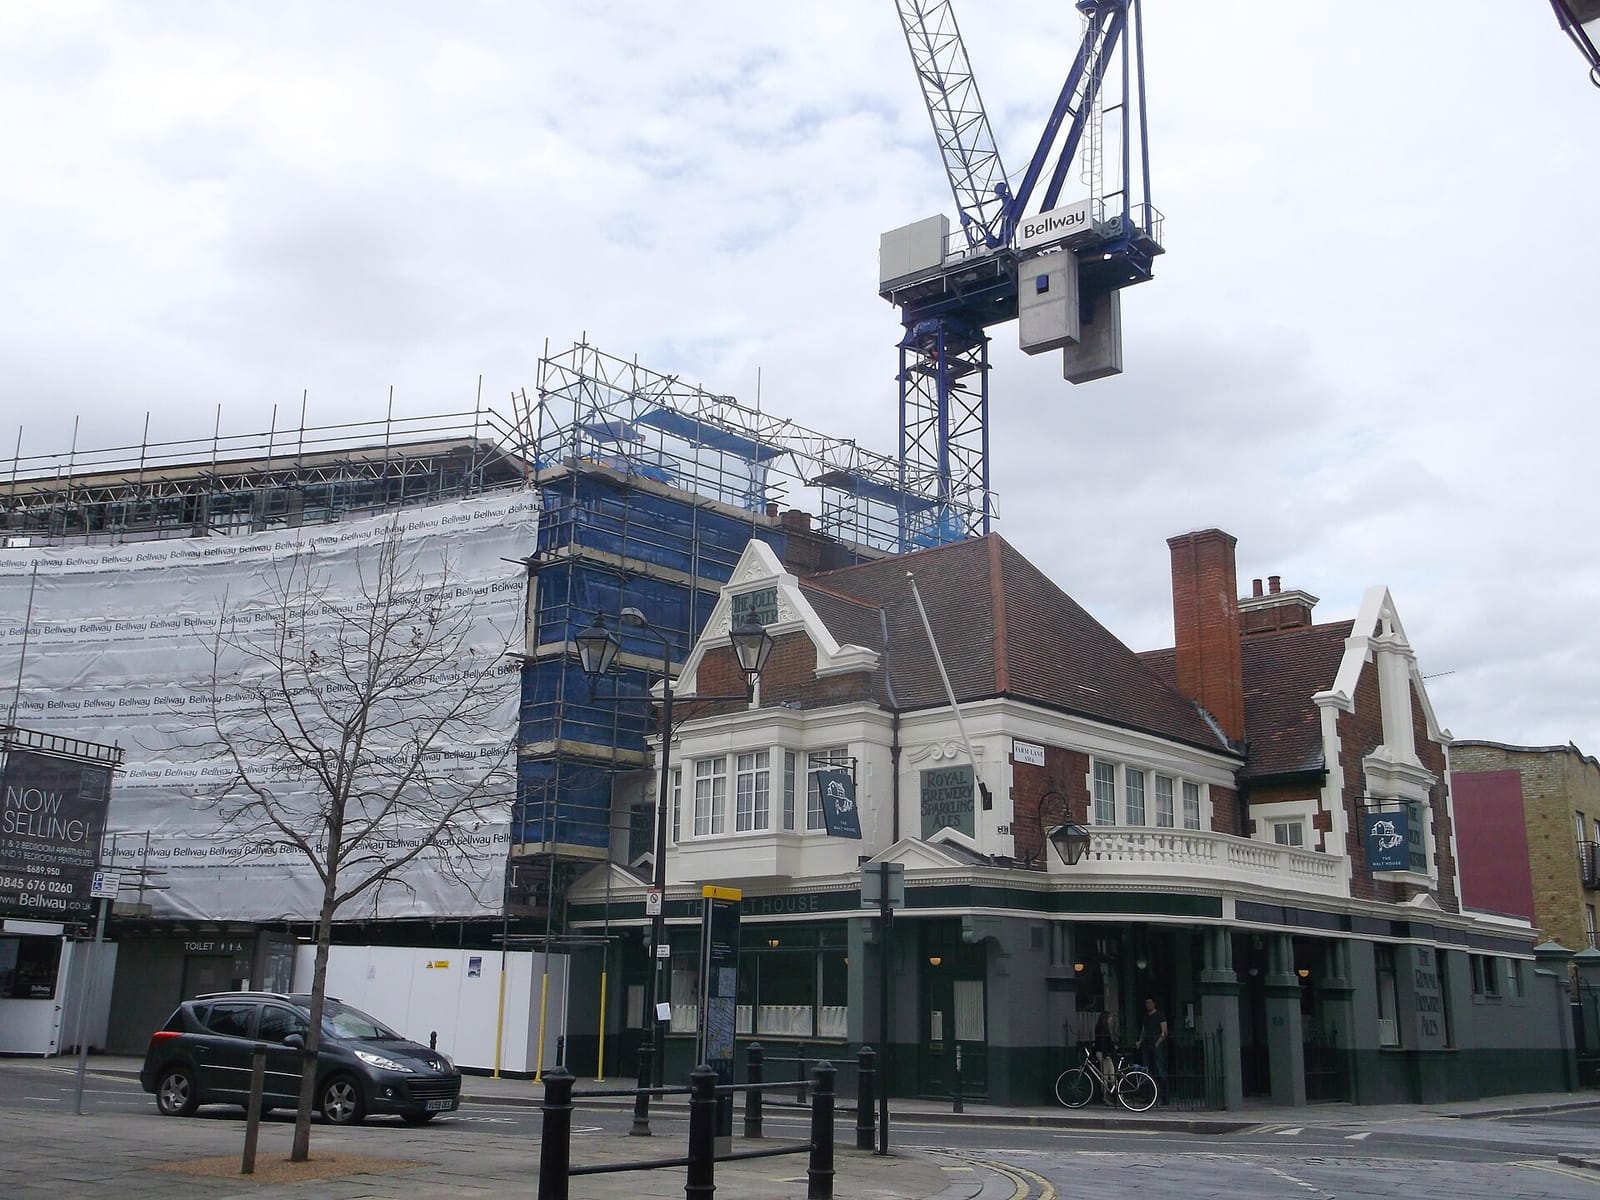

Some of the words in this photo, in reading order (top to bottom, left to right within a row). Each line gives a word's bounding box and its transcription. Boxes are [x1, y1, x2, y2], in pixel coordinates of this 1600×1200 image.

[1024, 210, 1085, 239] Bellway
[102, 556, 133, 565] Bellway
[44, 626, 77, 634] Bellway
[80, 624, 112, 633] Bellway
[115, 622, 148, 632] Bellway
[150, 620, 181, 630] Bellway
[184, 618, 218, 627] Bellway
[456, 586, 488, 598] Bellway
[491, 582, 524, 593] Bellway
[48, 700, 80, 709] Bellway
[84, 698, 116, 708] Bellway
[118, 697, 150, 707] Bellway
[154, 696, 186, 705] Bellway
[129, 769, 162, 779] Bellway
[164, 768, 198, 778] Bellway
[200, 766, 234, 776] Bellway
[411, 754, 441, 763] Bllway
[927, 770, 968, 788] ROYAL
[6, 785, 64, 814] NOW
[922, 786, 973, 803] BREWERY
[920, 800, 974, 816] SPARKLING
[2, 810, 90, 844] SELLING!
[933, 814, 961, 829] ALES
[22, 842, 55, 853] BEDROOM
[102, 848, 136, 857] Bellway
[137, 848, 170, 857] Bellway
[173, 848, 208, 857] Bellway
[210, 846, 243, 856] Bellway
[24, 852, 57, 862] BEDROOM
[26, 864, 60, 876] £689,950
[0, 876, 24, 889] 0845
[26, 880, 46, 891] 676
[48, 882, 73, 894] 0260
[762, 896, 819, 912] HOUSE
[184, 942, 214, 951] TOILET
